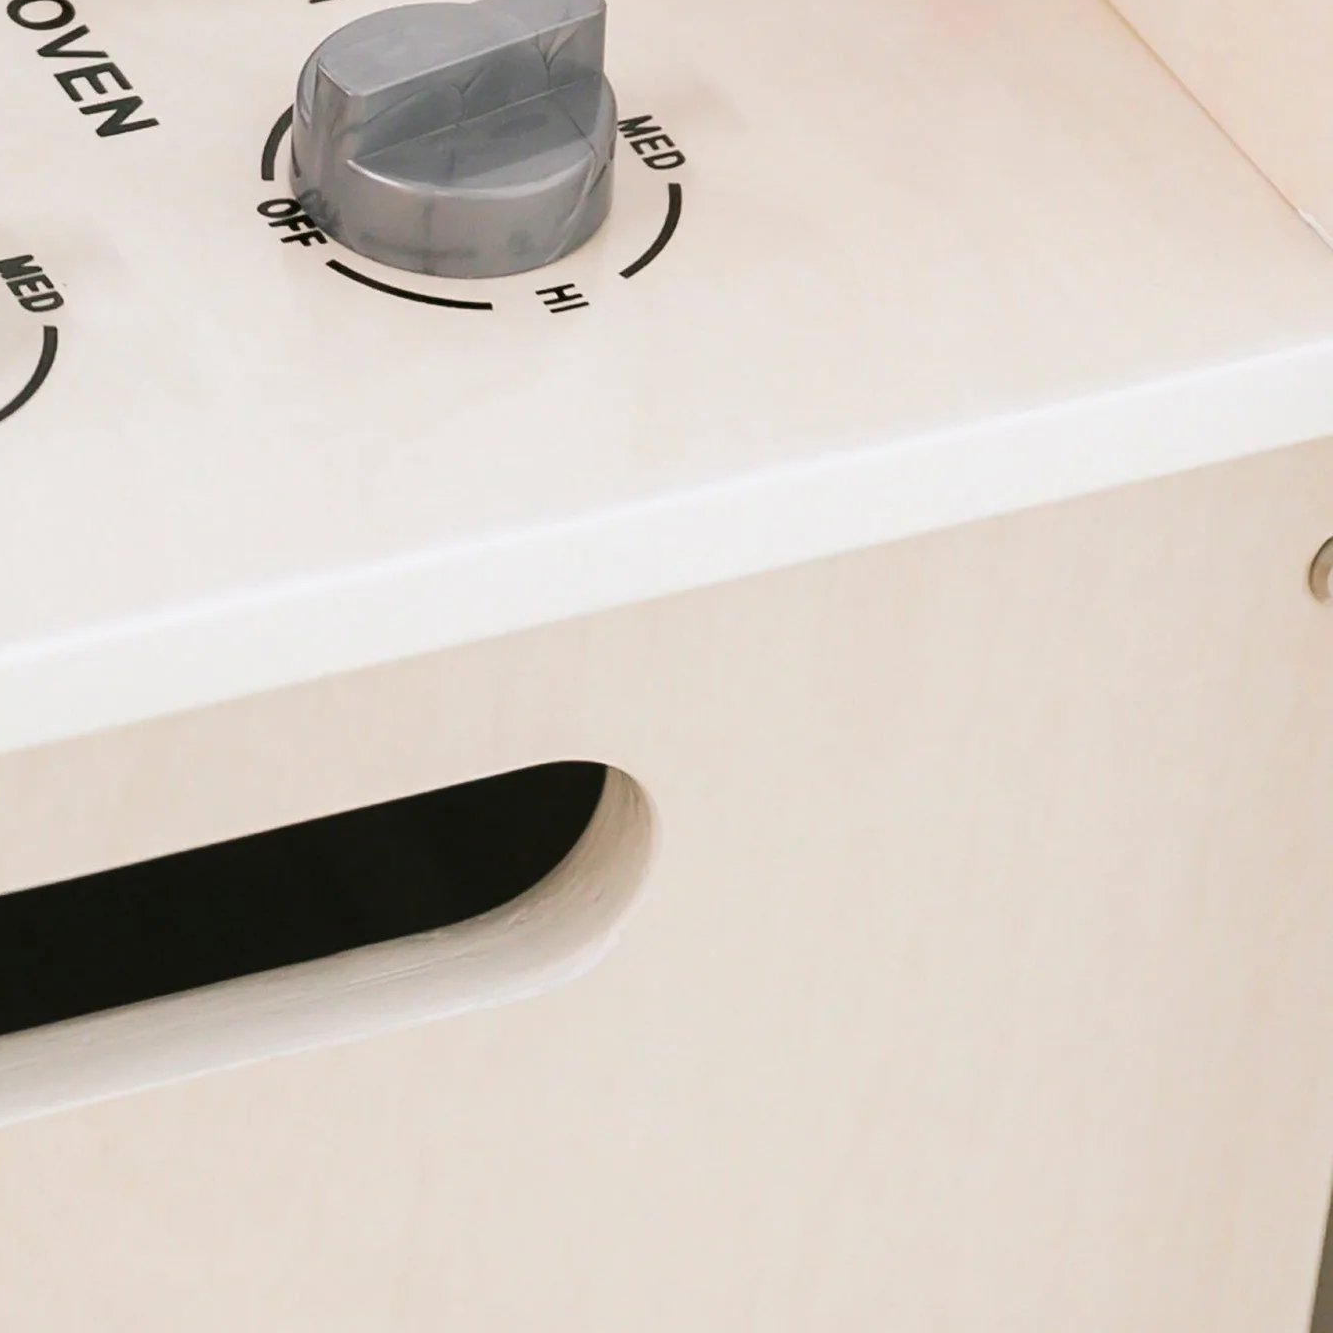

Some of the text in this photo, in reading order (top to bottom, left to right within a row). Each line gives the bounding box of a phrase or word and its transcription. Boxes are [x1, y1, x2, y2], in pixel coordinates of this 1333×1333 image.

[617, 114, 687, 171] MED
[256, 197, 327, 247] OFF
[535, 283, 589, 314] HI
